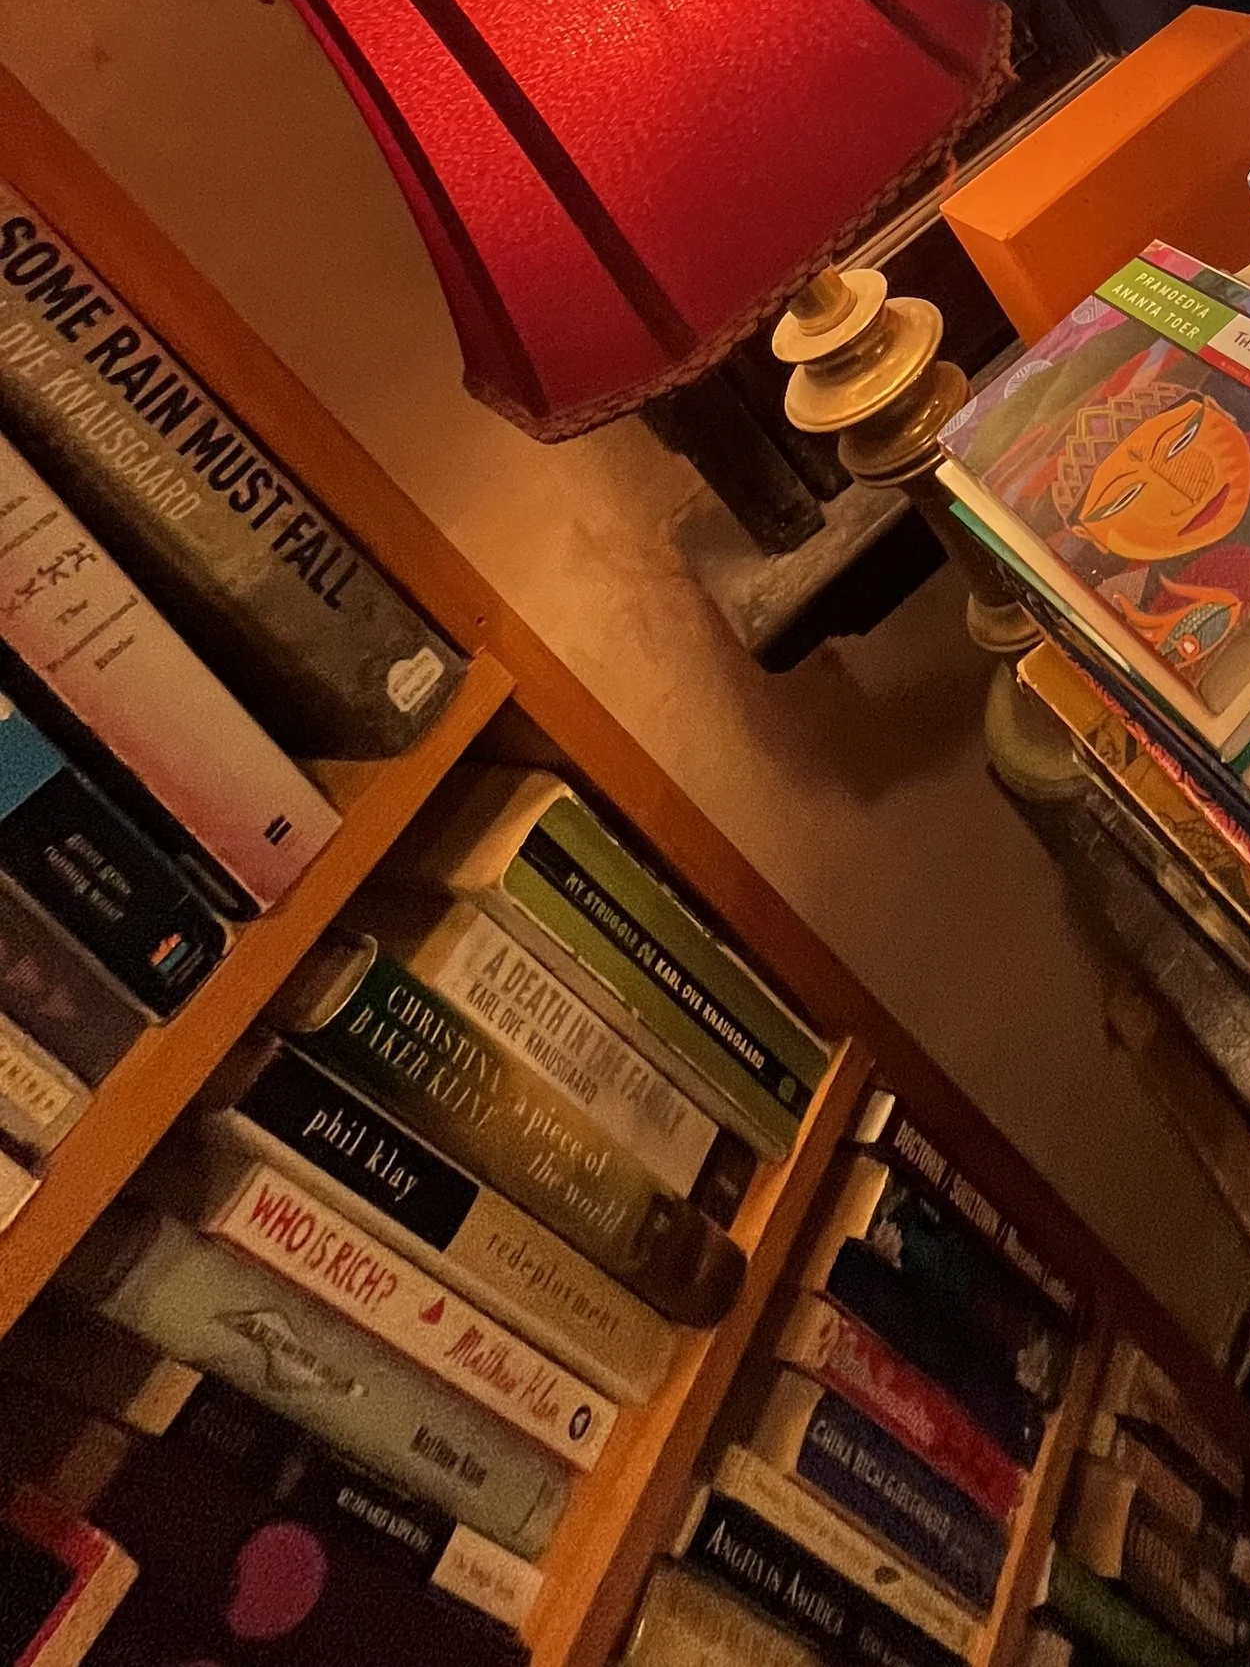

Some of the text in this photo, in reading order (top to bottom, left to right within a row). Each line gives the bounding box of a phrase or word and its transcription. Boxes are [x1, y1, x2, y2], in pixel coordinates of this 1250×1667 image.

[1112, 284, 1200, 340] ANANTA TOER
[1135, 272, 1210, 319] PRAMOEDYA
[0, 216, 359, 611] SOME RAIN MUST FALL
[1, 321, 60, 379] OVE
[42, 363, 199, 522] KNAUSGAARD
[387, 984, 504, 1095] CHRISTINA
[466, 981, 597, 1106] KARL OVE KNAUSGAARD
[482, 945, 509, 985] A
[501, 965, 571, 1031] DEATH
[652, 957, 681, 994] KARL
[680, 984, 703, 1012] OVE
[702, 1002, 765, 1072] KNAUSGAARD
[348, 1006, 500, 1133] BAKER KLINE
[302, 1107, 419, 1202] phil klay
[512, 1097, 614, 1178] a piece of
[526, 1148, 629, 1234] the world
[248, 1182, 399, 1313] WHO IS RICH?
